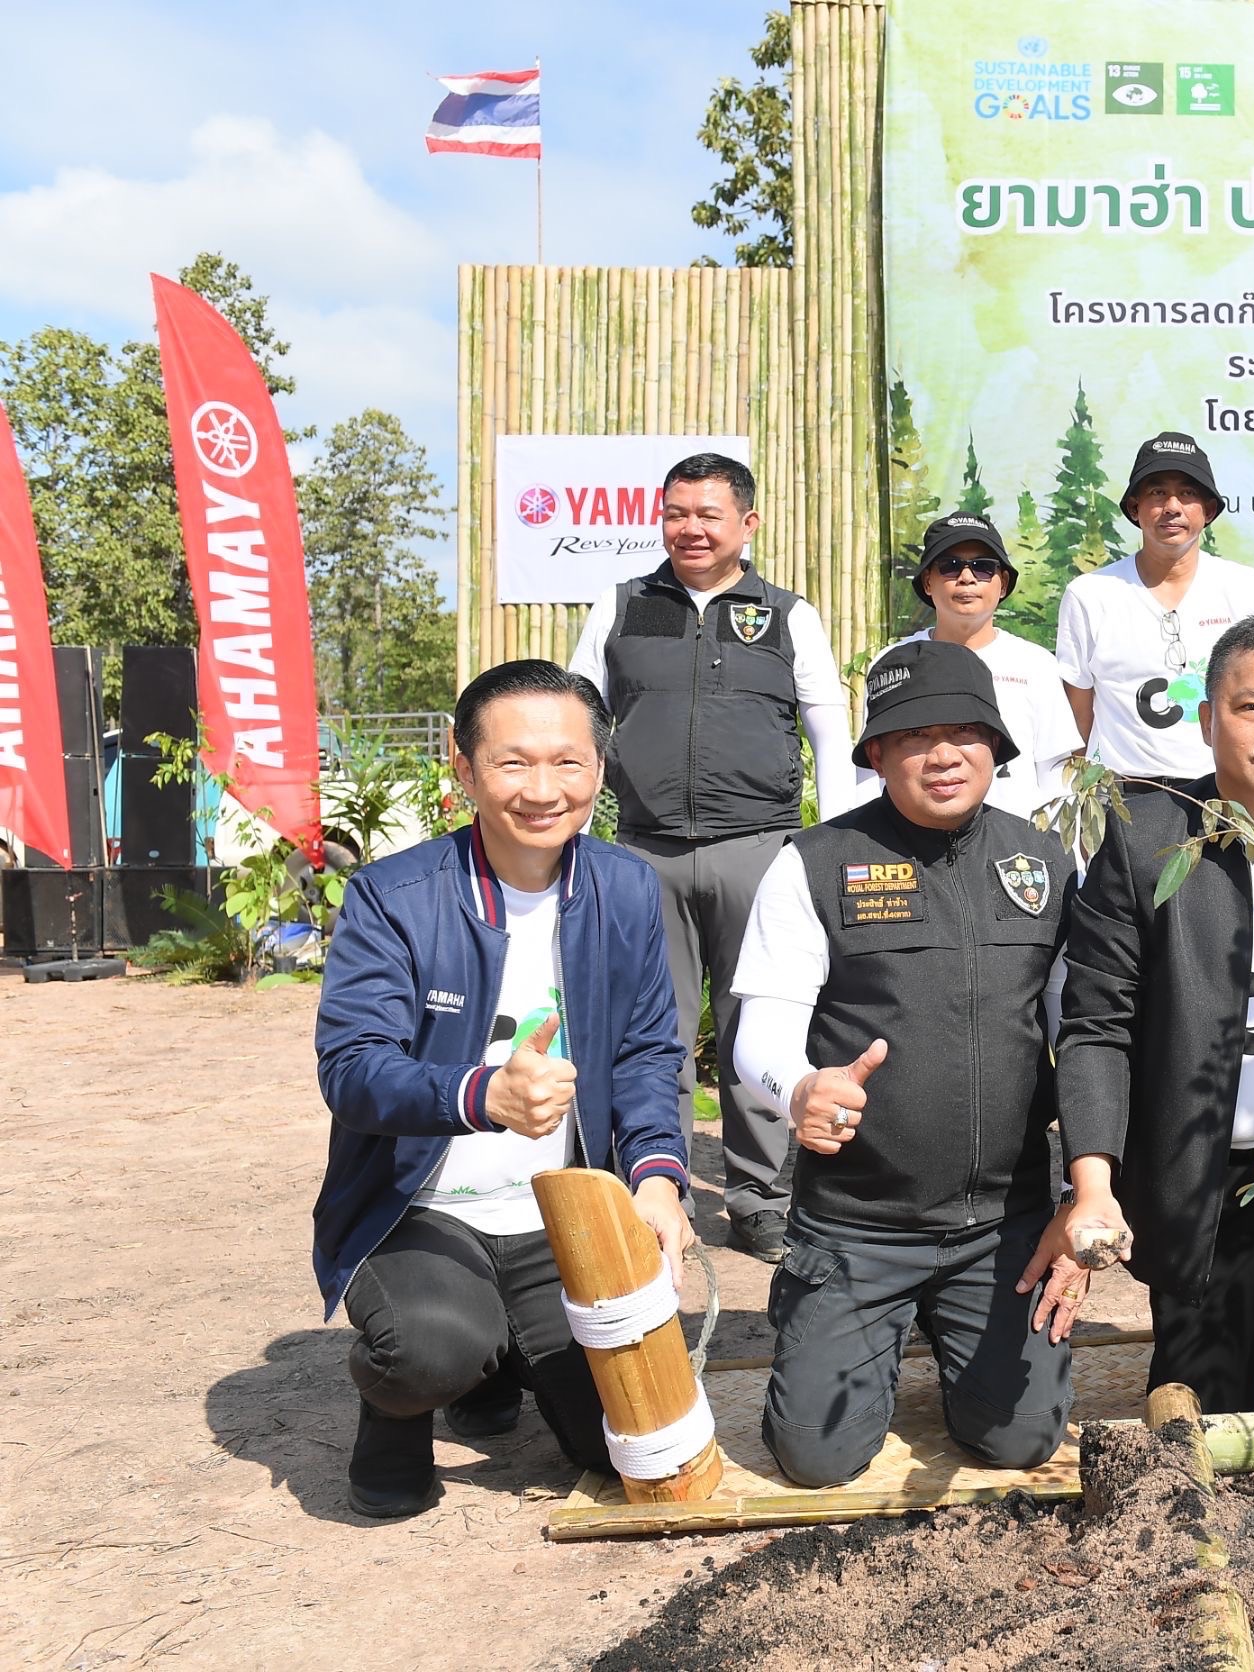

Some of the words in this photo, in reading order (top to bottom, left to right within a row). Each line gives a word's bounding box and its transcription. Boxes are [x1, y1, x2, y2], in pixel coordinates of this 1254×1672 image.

[974, 61, 1092, 77] SUSTAINABLE
[974, 78, 1091, 93] DEVELOPMENT
[974, 93, 1092, 121] GOALS
[961, 163, 1202, 229] ยามาฮ่า
[1163, 440, 1196, 454] YAMAHA
[550, 535, 614, 557] Revs
[869, 862, 914, 881] RFD
[847, 883, 865, 893] ROYAL
[865, 882, 884, 893] FOREST
[885, 881, 917, 892] DEPARTMENT
